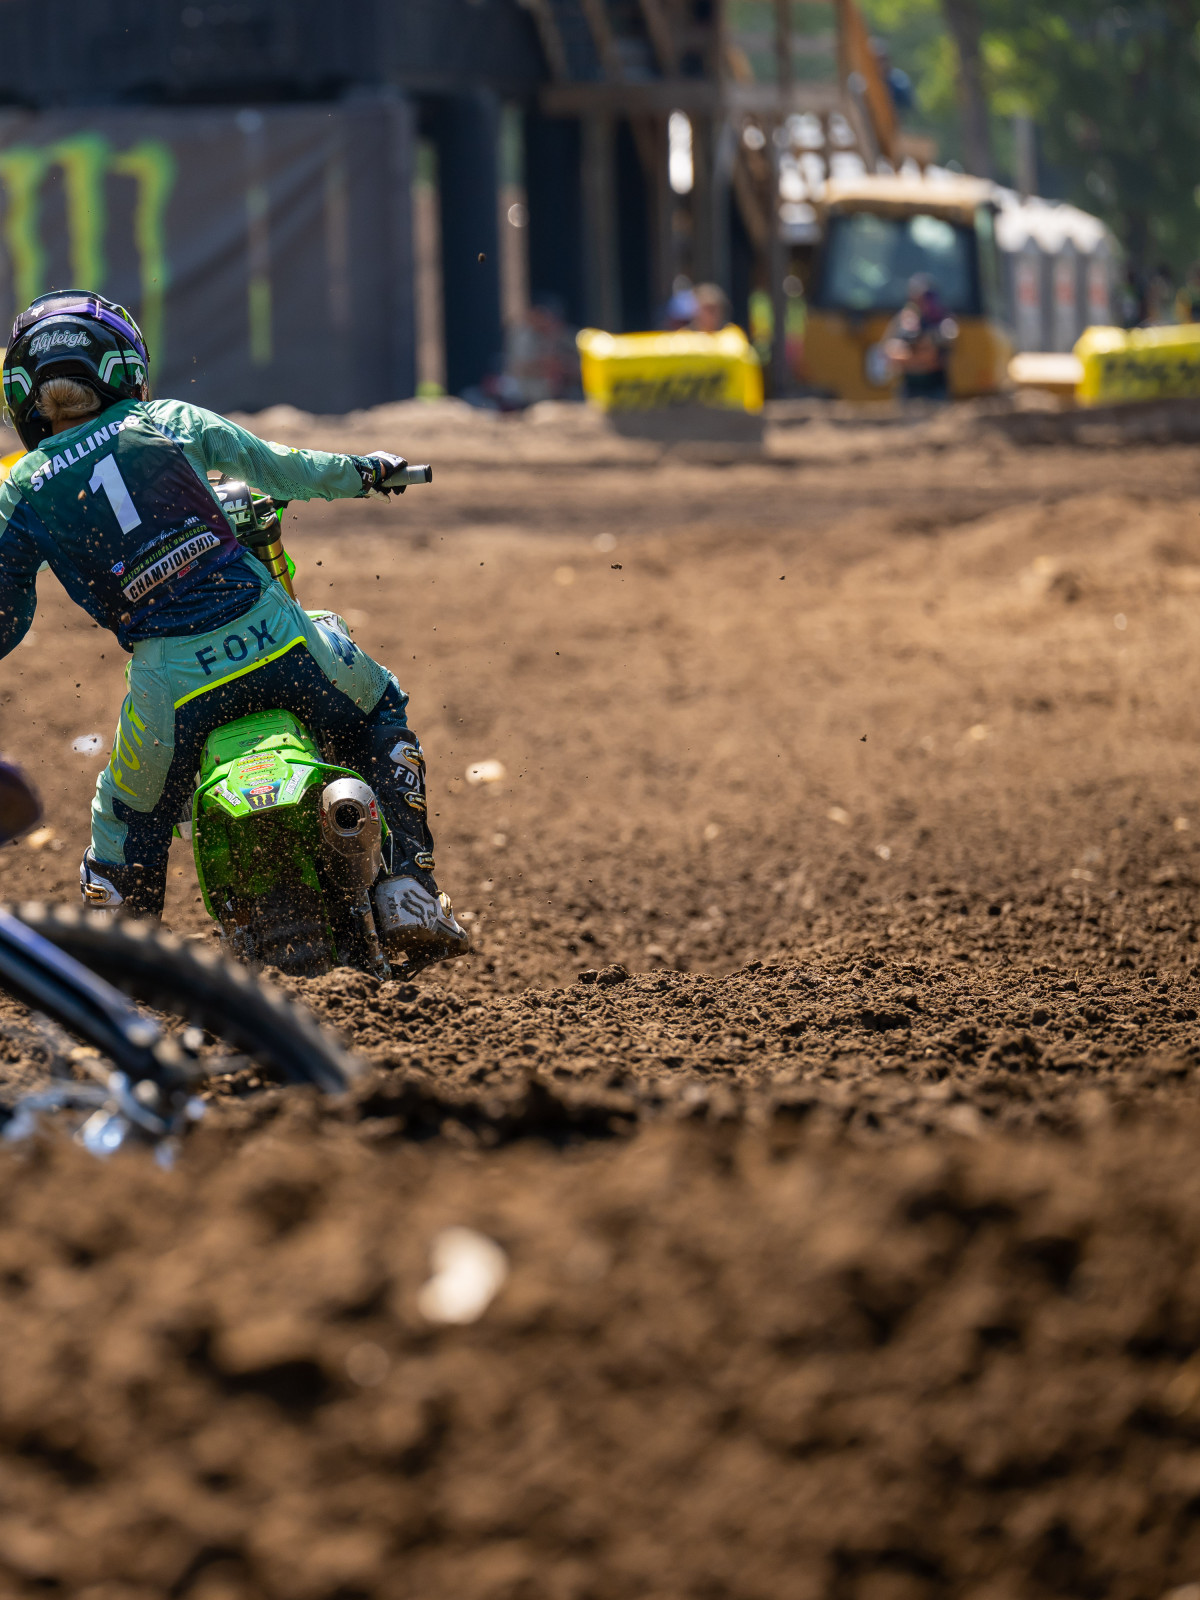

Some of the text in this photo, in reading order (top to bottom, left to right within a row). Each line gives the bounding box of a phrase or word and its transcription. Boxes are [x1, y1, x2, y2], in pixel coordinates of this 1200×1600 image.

[28, 330, 92, 356] Kyleigh
[30, 414, 140, 492] STALLINGS
[88, 452, 142, 535] 1
[120, 524, 208, 588] AMATEUR NATIONAL MOTOCROSS
[128, 534, 215, 601] CHAMPIONSHIP
[195, 619, 276, 676] FOX
